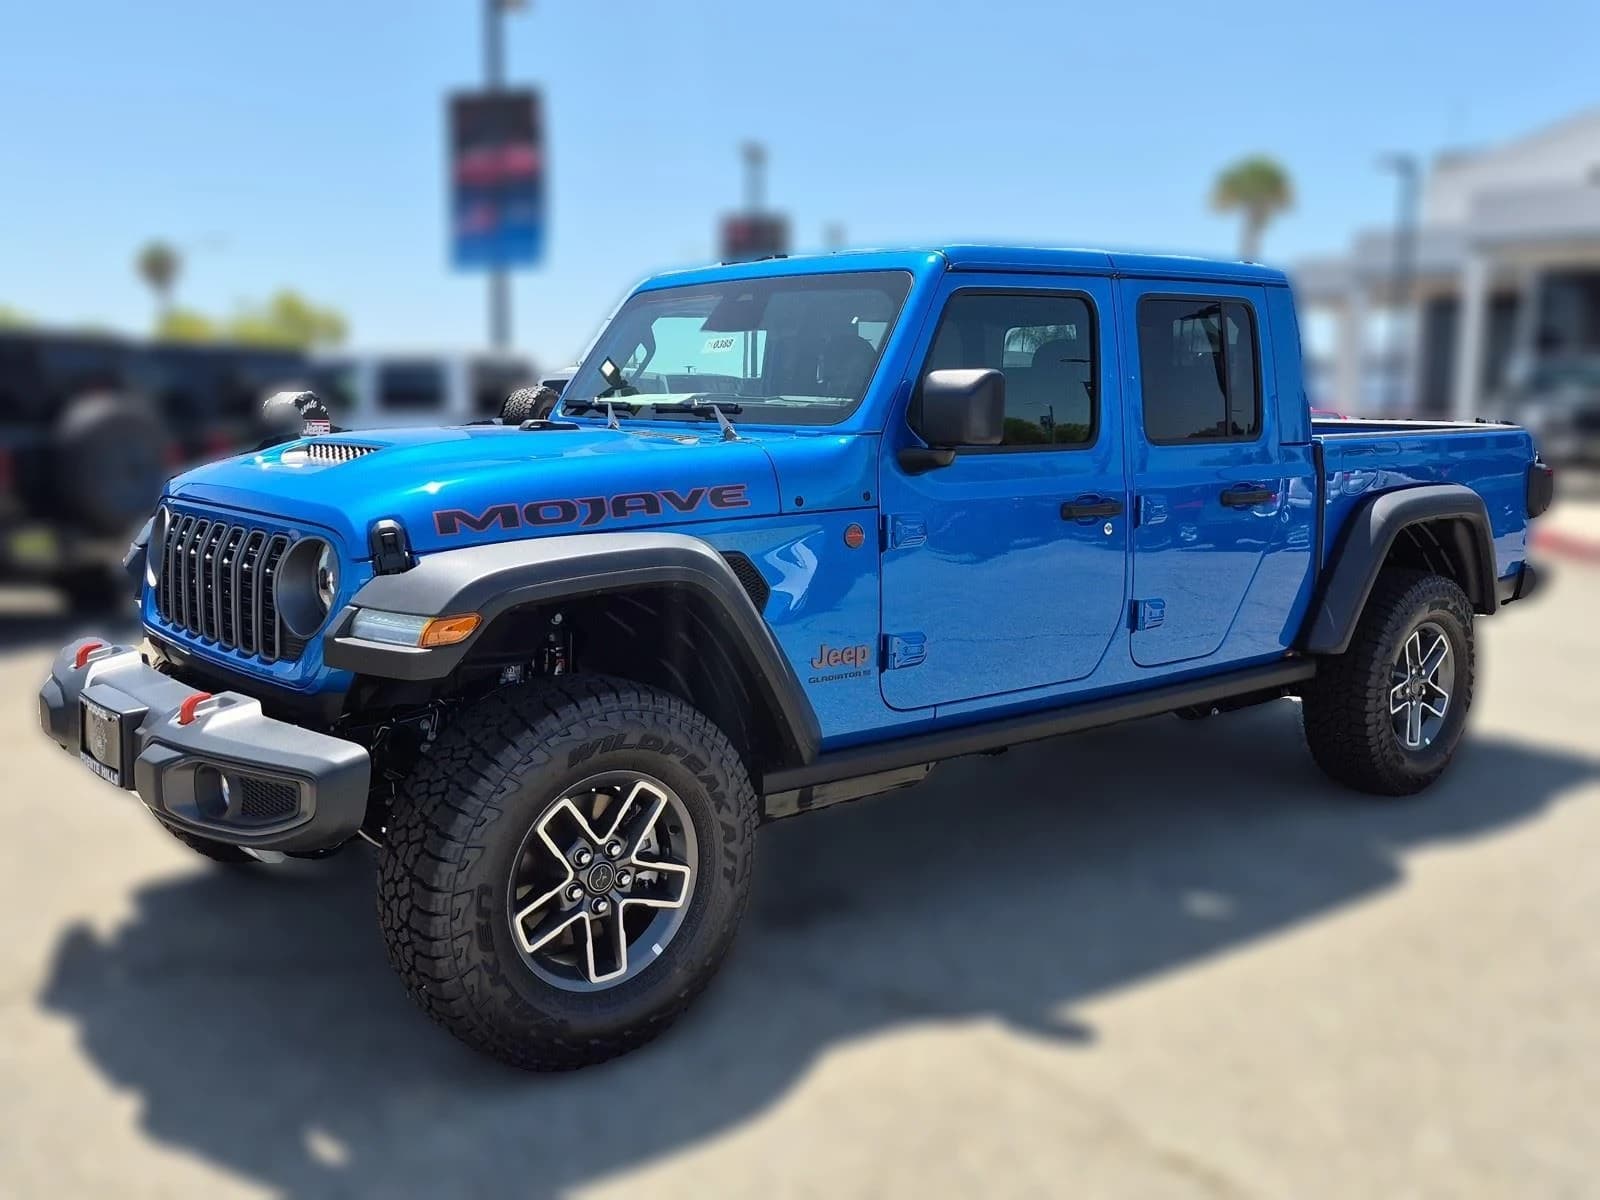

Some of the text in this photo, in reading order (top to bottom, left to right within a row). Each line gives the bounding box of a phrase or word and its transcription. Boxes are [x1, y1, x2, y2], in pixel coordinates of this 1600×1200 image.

[433, 483, 751, 536] MOJAVE
[810, 643, 870, 669] Jeep
[808, 671, 861, 684] GLADIATOR
[567, 732, 732, 815] WILDPEAK
